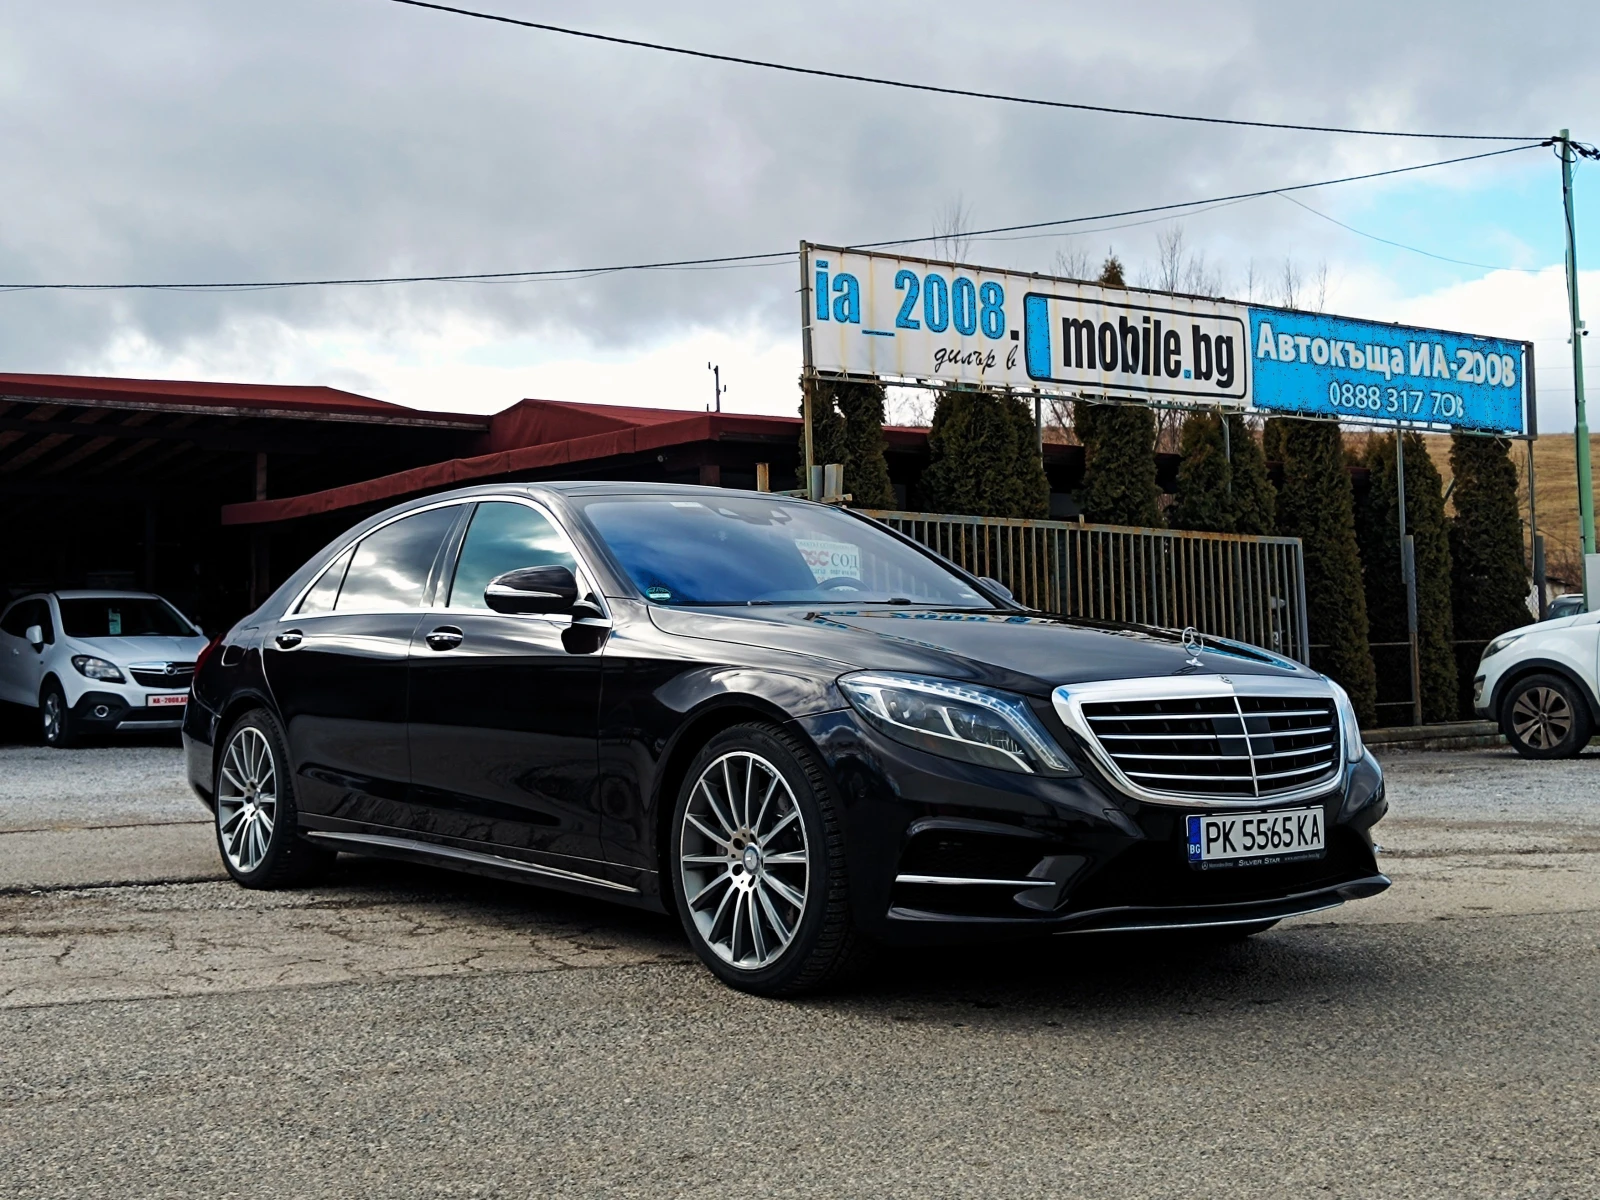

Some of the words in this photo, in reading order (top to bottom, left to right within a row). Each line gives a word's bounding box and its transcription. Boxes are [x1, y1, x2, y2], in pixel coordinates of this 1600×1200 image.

[934, 347, 996, 375] дилър
[1006, 344, 1018, 370] в
[1062, 316, 1234, 389] mobile.bg
[1256, 321, 1404, 381] Автокъща
[1409, 341, 1516, 388] ИА-2008
[1329, 381, 1381, 411] 0888
[1386, 388, 1423, 414] 317
[1190, 844, 1200, 854] BG
[1205, 821, 1237, 854] PK
[1242, 816, 1294, 851] 5565
[1297, 814, 1321, 846] KA
